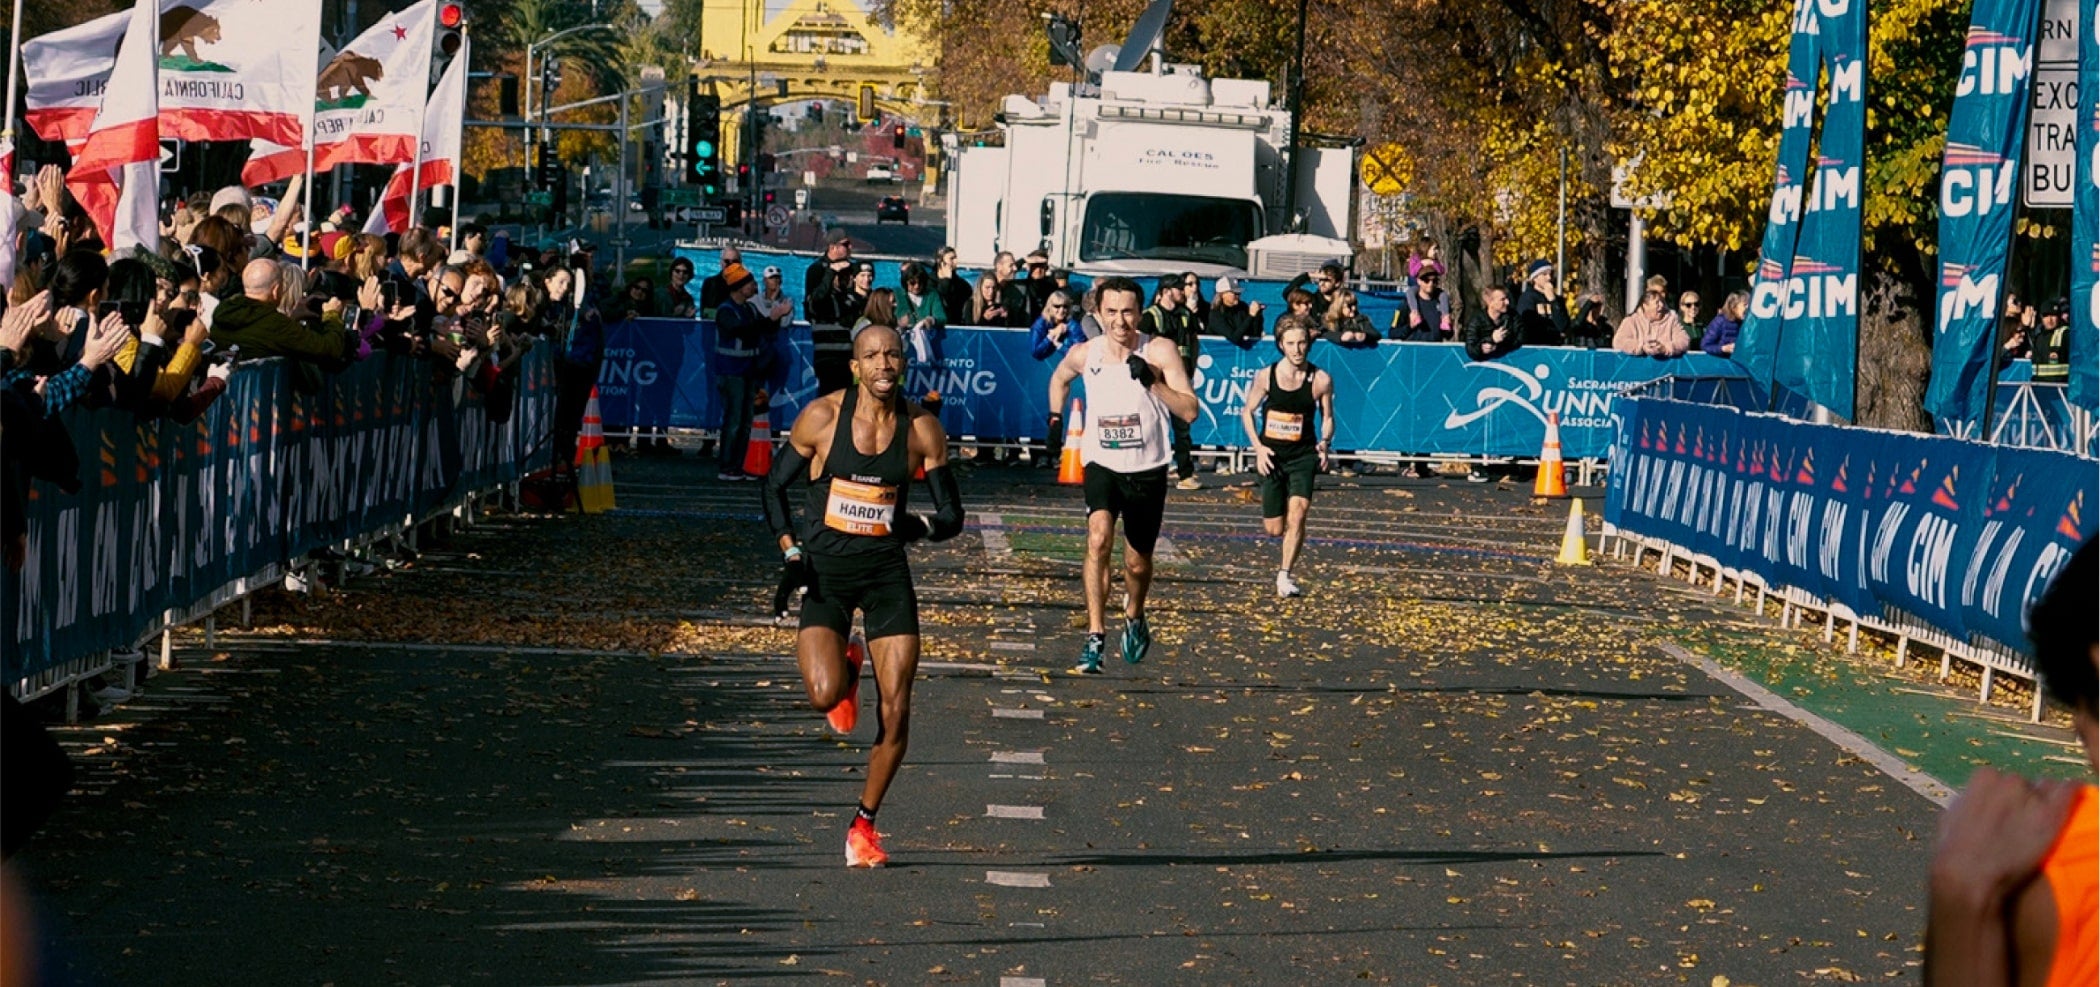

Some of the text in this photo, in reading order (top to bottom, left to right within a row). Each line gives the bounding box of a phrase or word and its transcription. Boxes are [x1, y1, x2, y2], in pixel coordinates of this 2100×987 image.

[1146, 149, 1214, 160] CAL OES
[2033, 164, 2070, 191] BU
[1783, 273, 1857, 320] CIM
[1104, 427, 1135, 439] 8382
[840, 502, 885, 521] HARDY
[1907, 511, 1959, 611] CIM
